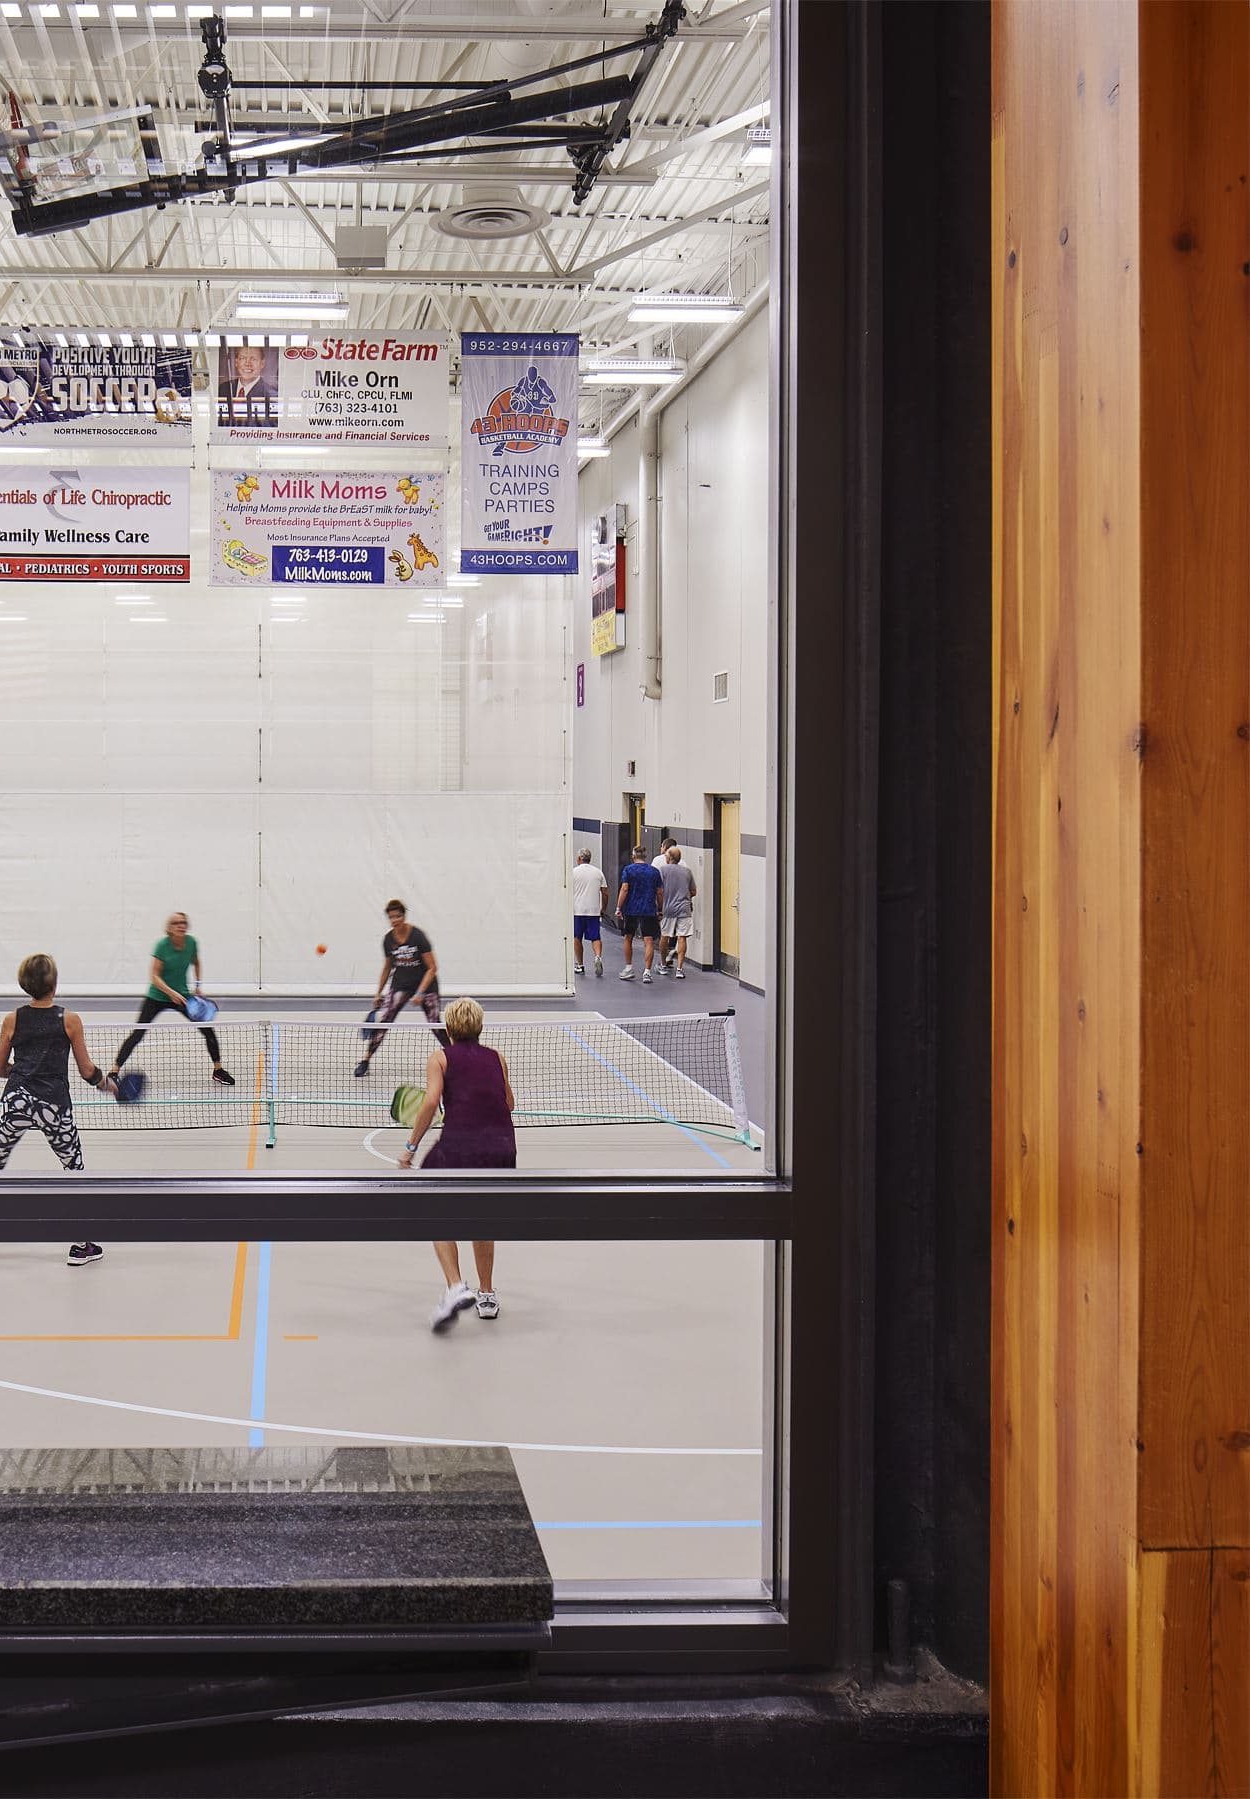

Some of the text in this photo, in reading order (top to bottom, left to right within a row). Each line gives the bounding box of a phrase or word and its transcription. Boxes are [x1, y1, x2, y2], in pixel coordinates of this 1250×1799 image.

[470, 341, 568, 352] 952-294-4667
[4, 349, 37, 360] METRO
[113, 347, 156, 364] YOUTH
[315, 371, 398, 387] Mike Orn
[53, 377, 156, 412] SOCCER
[301, 391, 412, 401] CLU, ChFC, CPCU, FLMI
[315, 402, 398, 414] (763) 323-4101
[309, 417, 404, 427] www.mikeorn.com
[471, 414, 570, 436] 43 HOOPS
[230, 430, 430, 441] Providing Insurance and Financial Services
[481, 433, 560, 444] BASKETBALL ACADEMY
[479, 464, 559, 477] TRAINING
[272, 480, 387, 500] Milk Moms
[490, 483, 549, 495] CAMPS
[43, 489, 57, 505] of
[61, 489, 86, 505] Life
[92, 489, 171, 509] Chiropractic
[226, 503, 408, 515] Helping Moms provide the BrEaST milk for
[485, 500, 555, 513] PARTIES
[245, 517, 412, 529] Breastfeeding Equipment & Supplies
[45, 530, 110, 543] Wellness
[115, 530, 149, 543] Care
[290, 534, 327, 542] Insurance
[329, 534, 350, 542] Plans
[352, 534, 390, 544] Accepted
[289, 549, 368, 563] 763-413-0129
[470, 555, 567, 565] 43HOOPS.COM
[25, 563, 90, 574] PEDIATRICS
[102, 564, 138, 575] YOUTH
[141, 565, 184, 575] SPORTS
[285, 567, 372, 581] MilkMoms.com
